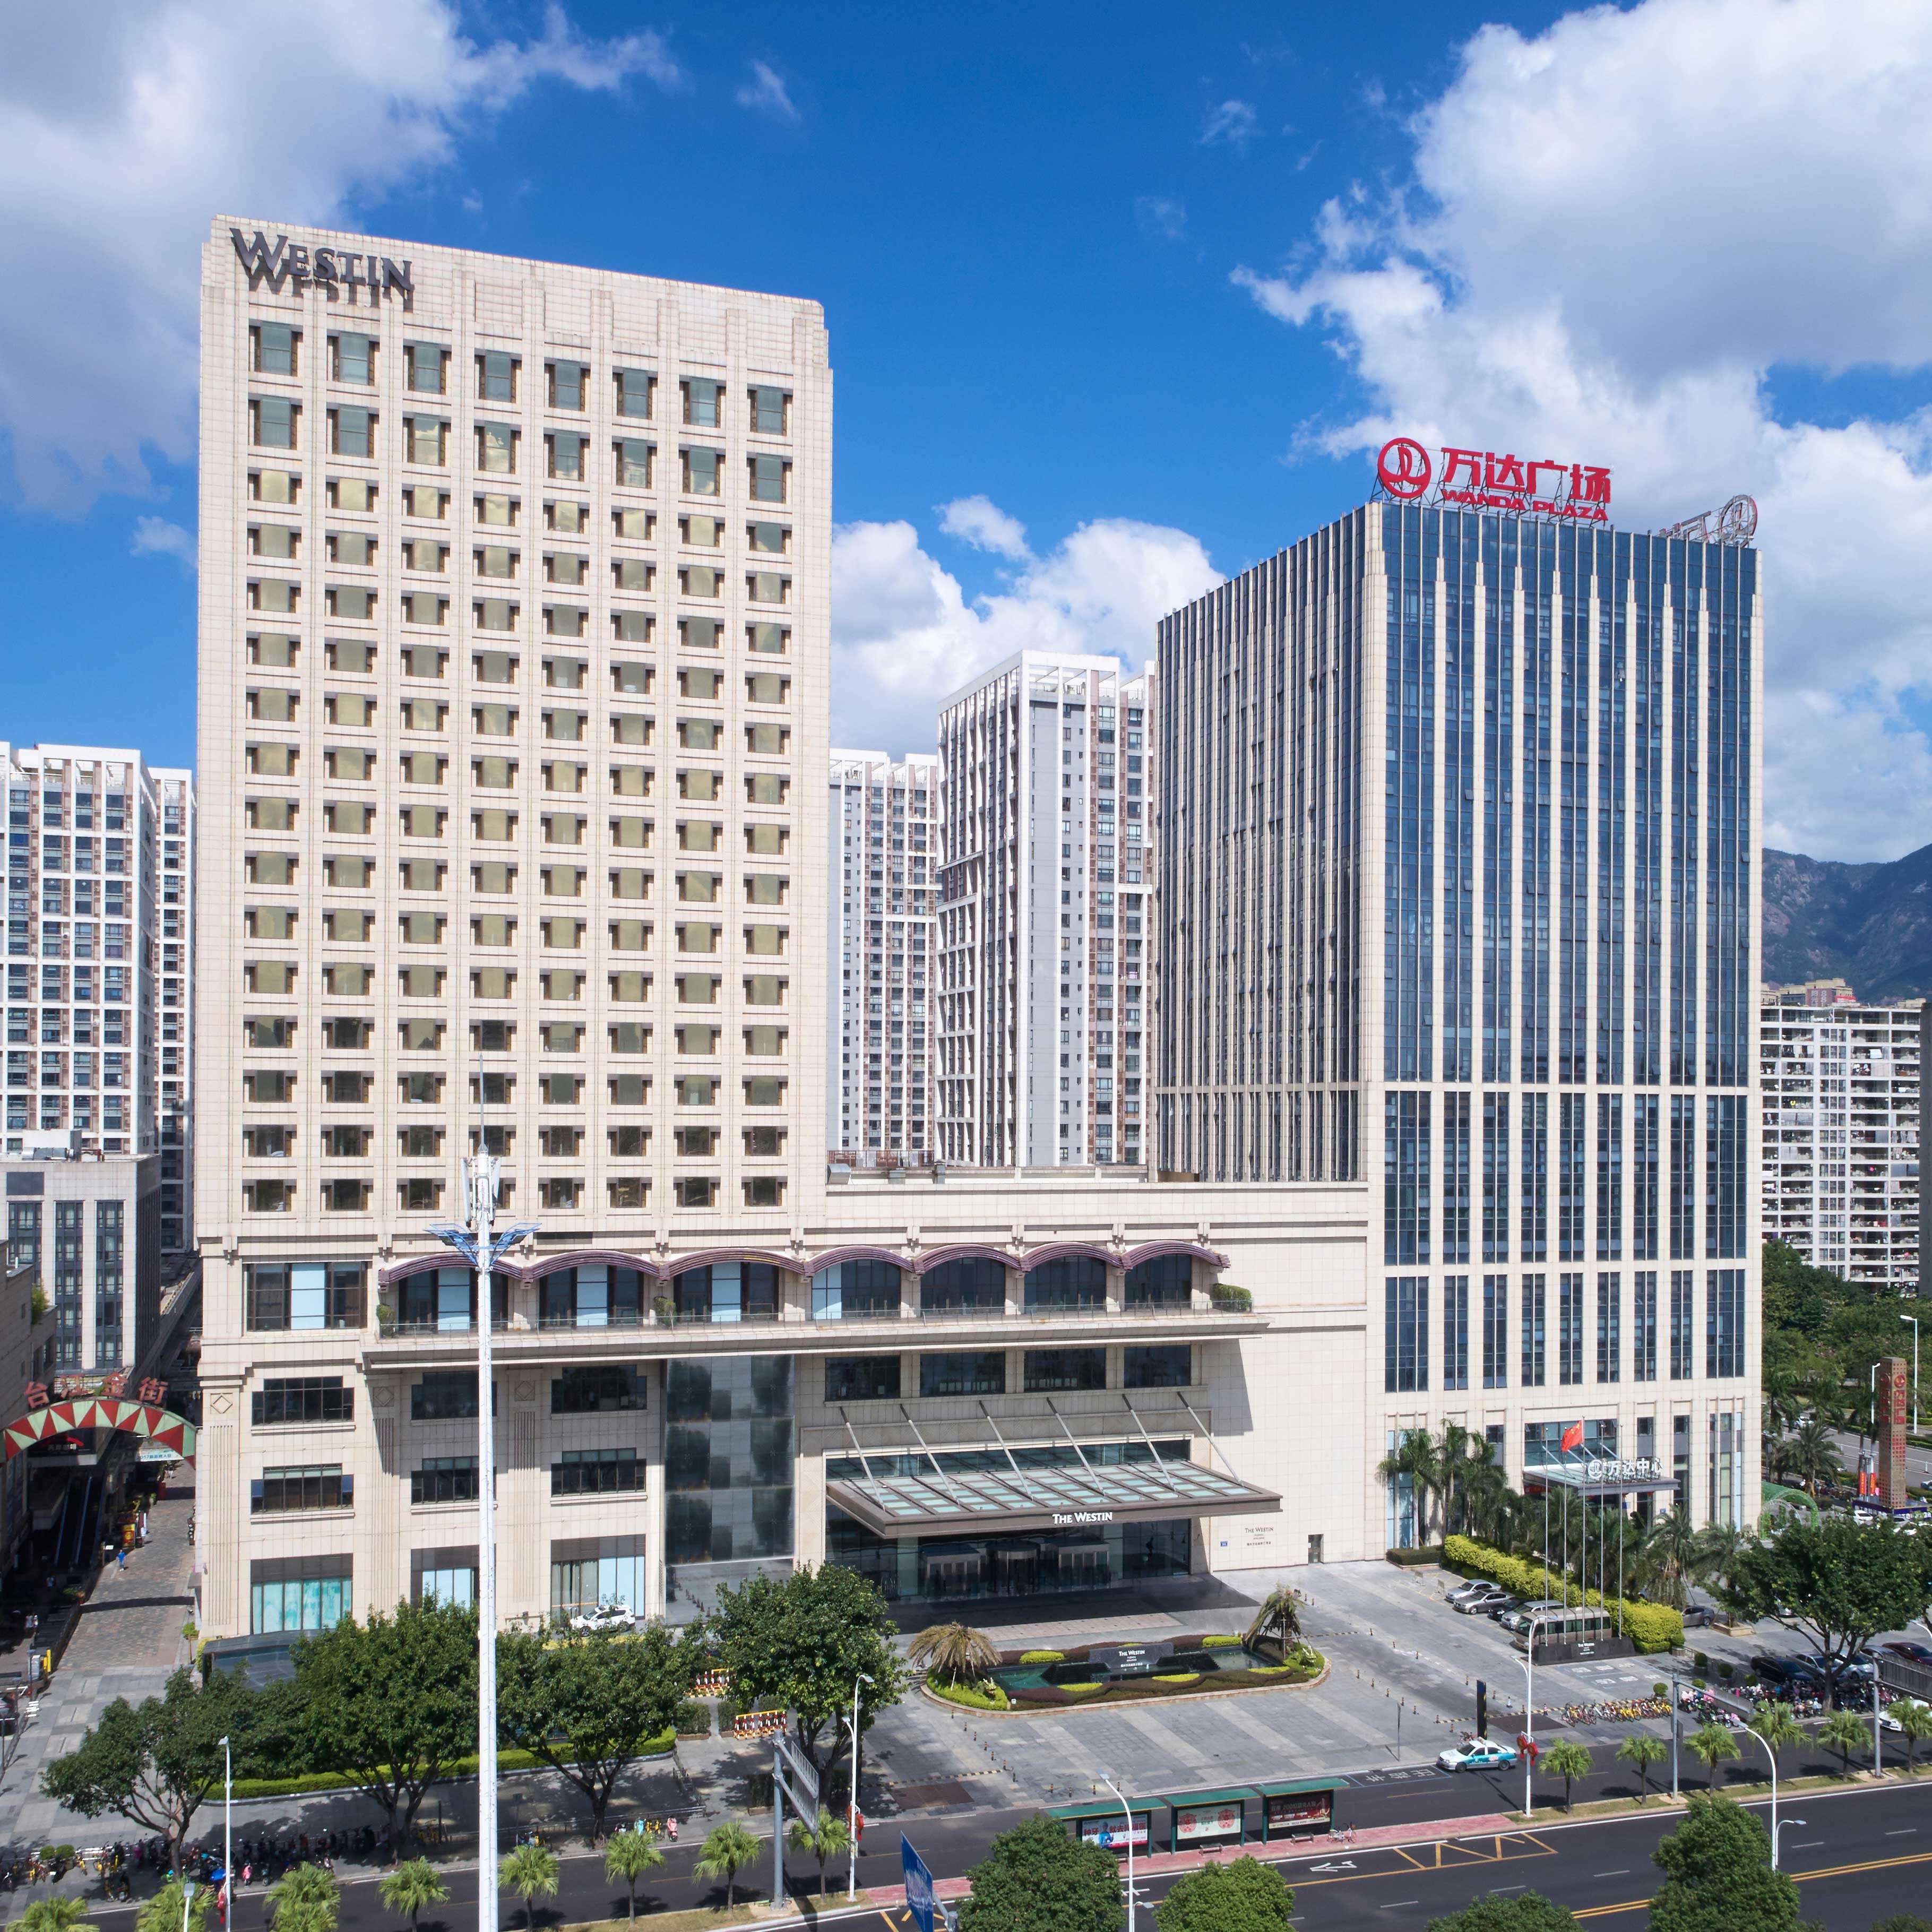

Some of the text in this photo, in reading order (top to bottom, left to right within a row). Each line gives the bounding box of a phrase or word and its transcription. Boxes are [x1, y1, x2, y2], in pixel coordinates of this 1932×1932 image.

[229, 228, 412, 292] WESTIN
[1441, 447, 1611, 504] 万达广场
[1442, 489, 1609, 521] WANDA PLAZA
[24, 1372, 168, 1408] 台江金街
[1608, 1457, 1663, 1476] 万达中心
[1052, 1512, 1113, 1524] THE WESTIN
